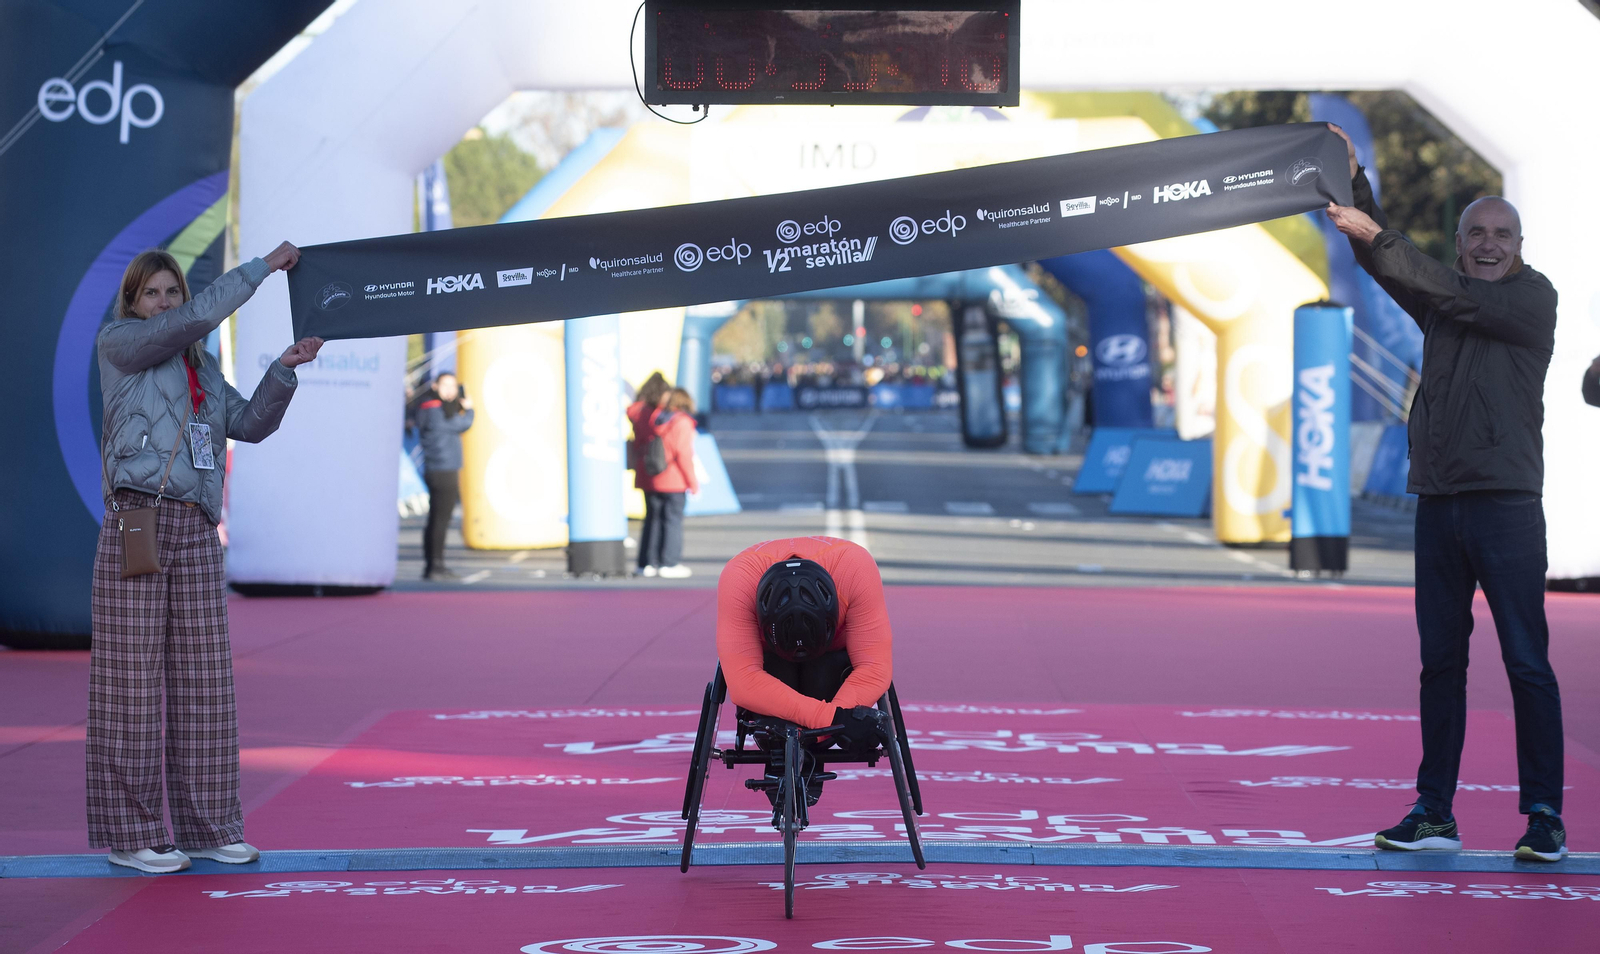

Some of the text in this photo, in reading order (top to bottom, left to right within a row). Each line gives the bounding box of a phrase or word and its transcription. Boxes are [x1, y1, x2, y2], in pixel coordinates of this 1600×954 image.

[38, 60, 165, 144] edp
[800, 143, 877, 169] IMD
[1224, 178, 1274, 191] Hyundauto Motor
[1238, 169, 1274, 181] HYUNDAI
[1153, 179, 1212, 204] HOKA
[803, 215, 842, 238] edp
[921, 209, 967, 238] edp
[998, 217, 1051, 229] Healthcare Partner
[706, 237, 752, 265] edp
[784, 237, 861, 258] maratón
[805, 249, 862, 269] sevilla
[611, 266, 664, 278] Healthcare Partner
[379, 281, 415, 291] HYUNDAI
[426, 273, 485, 295] HOKA
[364, 292, 397, 300] Hyundauto
[581, 332, 619, 462] HOKA
[1297, 362, 1336, 491] HOKA
[811, 934, 1213, 954] edp
